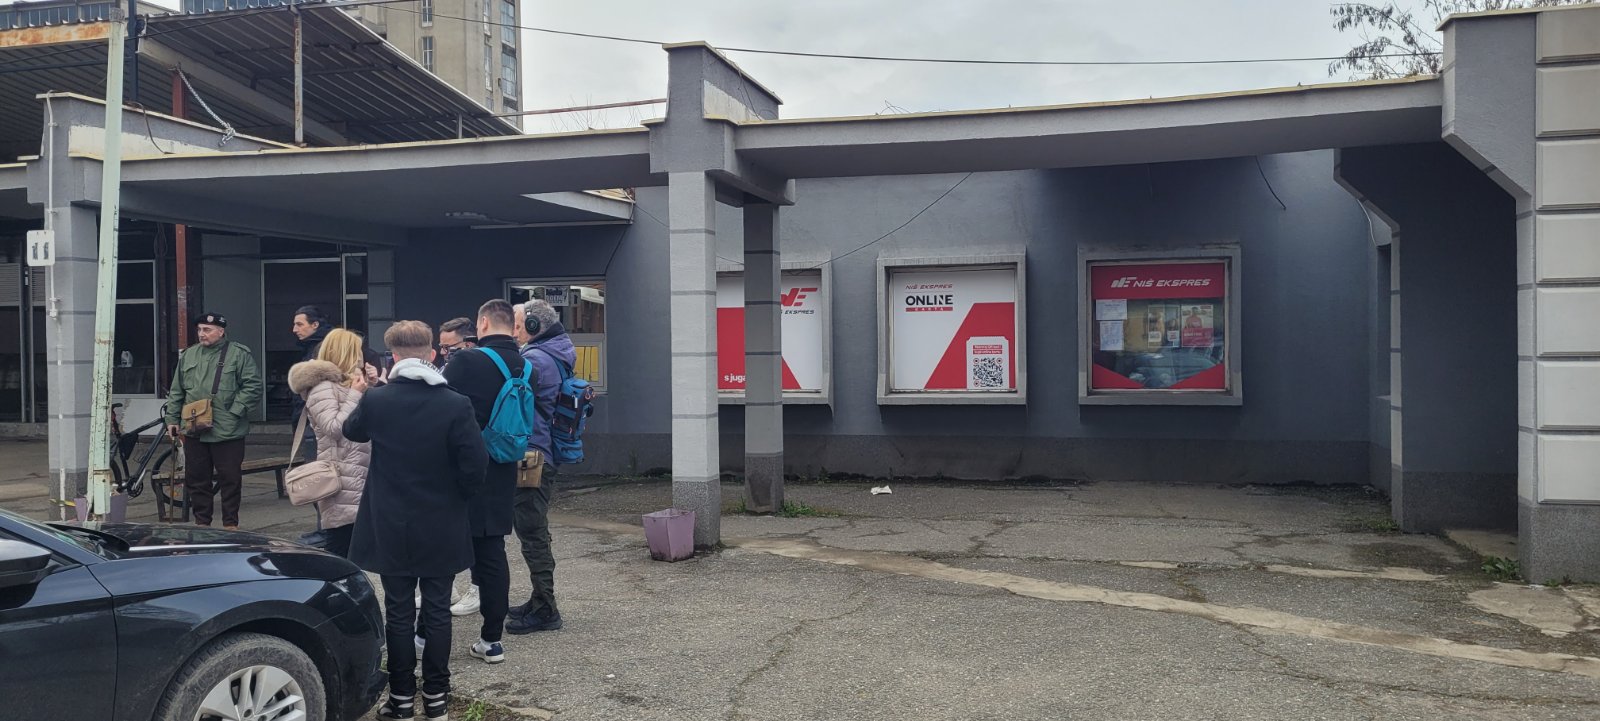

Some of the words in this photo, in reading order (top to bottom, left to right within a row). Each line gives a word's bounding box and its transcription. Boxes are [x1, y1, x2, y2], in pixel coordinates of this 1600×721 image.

[1133, 279, 1154, 287] NIŠ
[1156, 279, 1211, 287] EKSPRES
[905, 294, 954, 306] ONLINE
